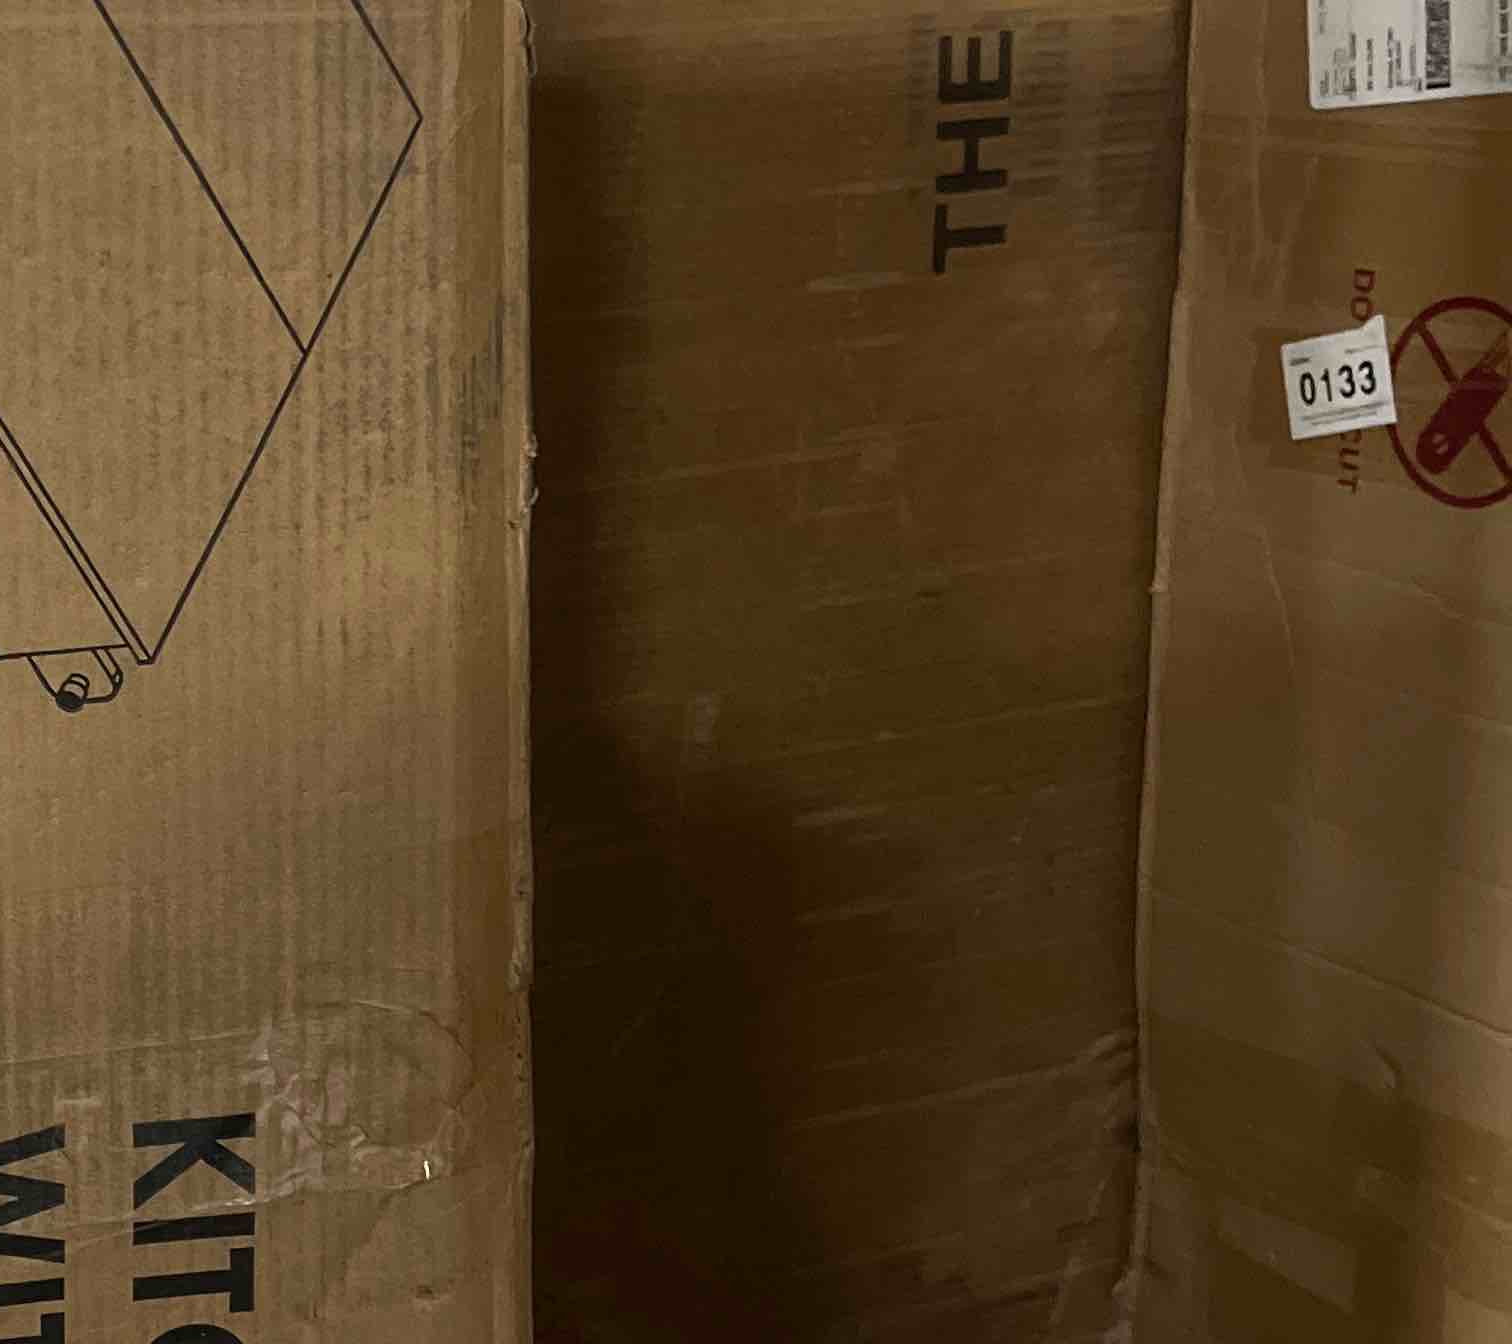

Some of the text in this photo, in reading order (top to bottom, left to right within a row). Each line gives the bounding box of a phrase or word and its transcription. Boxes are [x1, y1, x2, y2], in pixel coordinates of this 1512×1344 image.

[933, 30, 1013, 274] THE
[1350, 268, 1376, 321] DO
[1299, 360, 1377, 406] 0133
